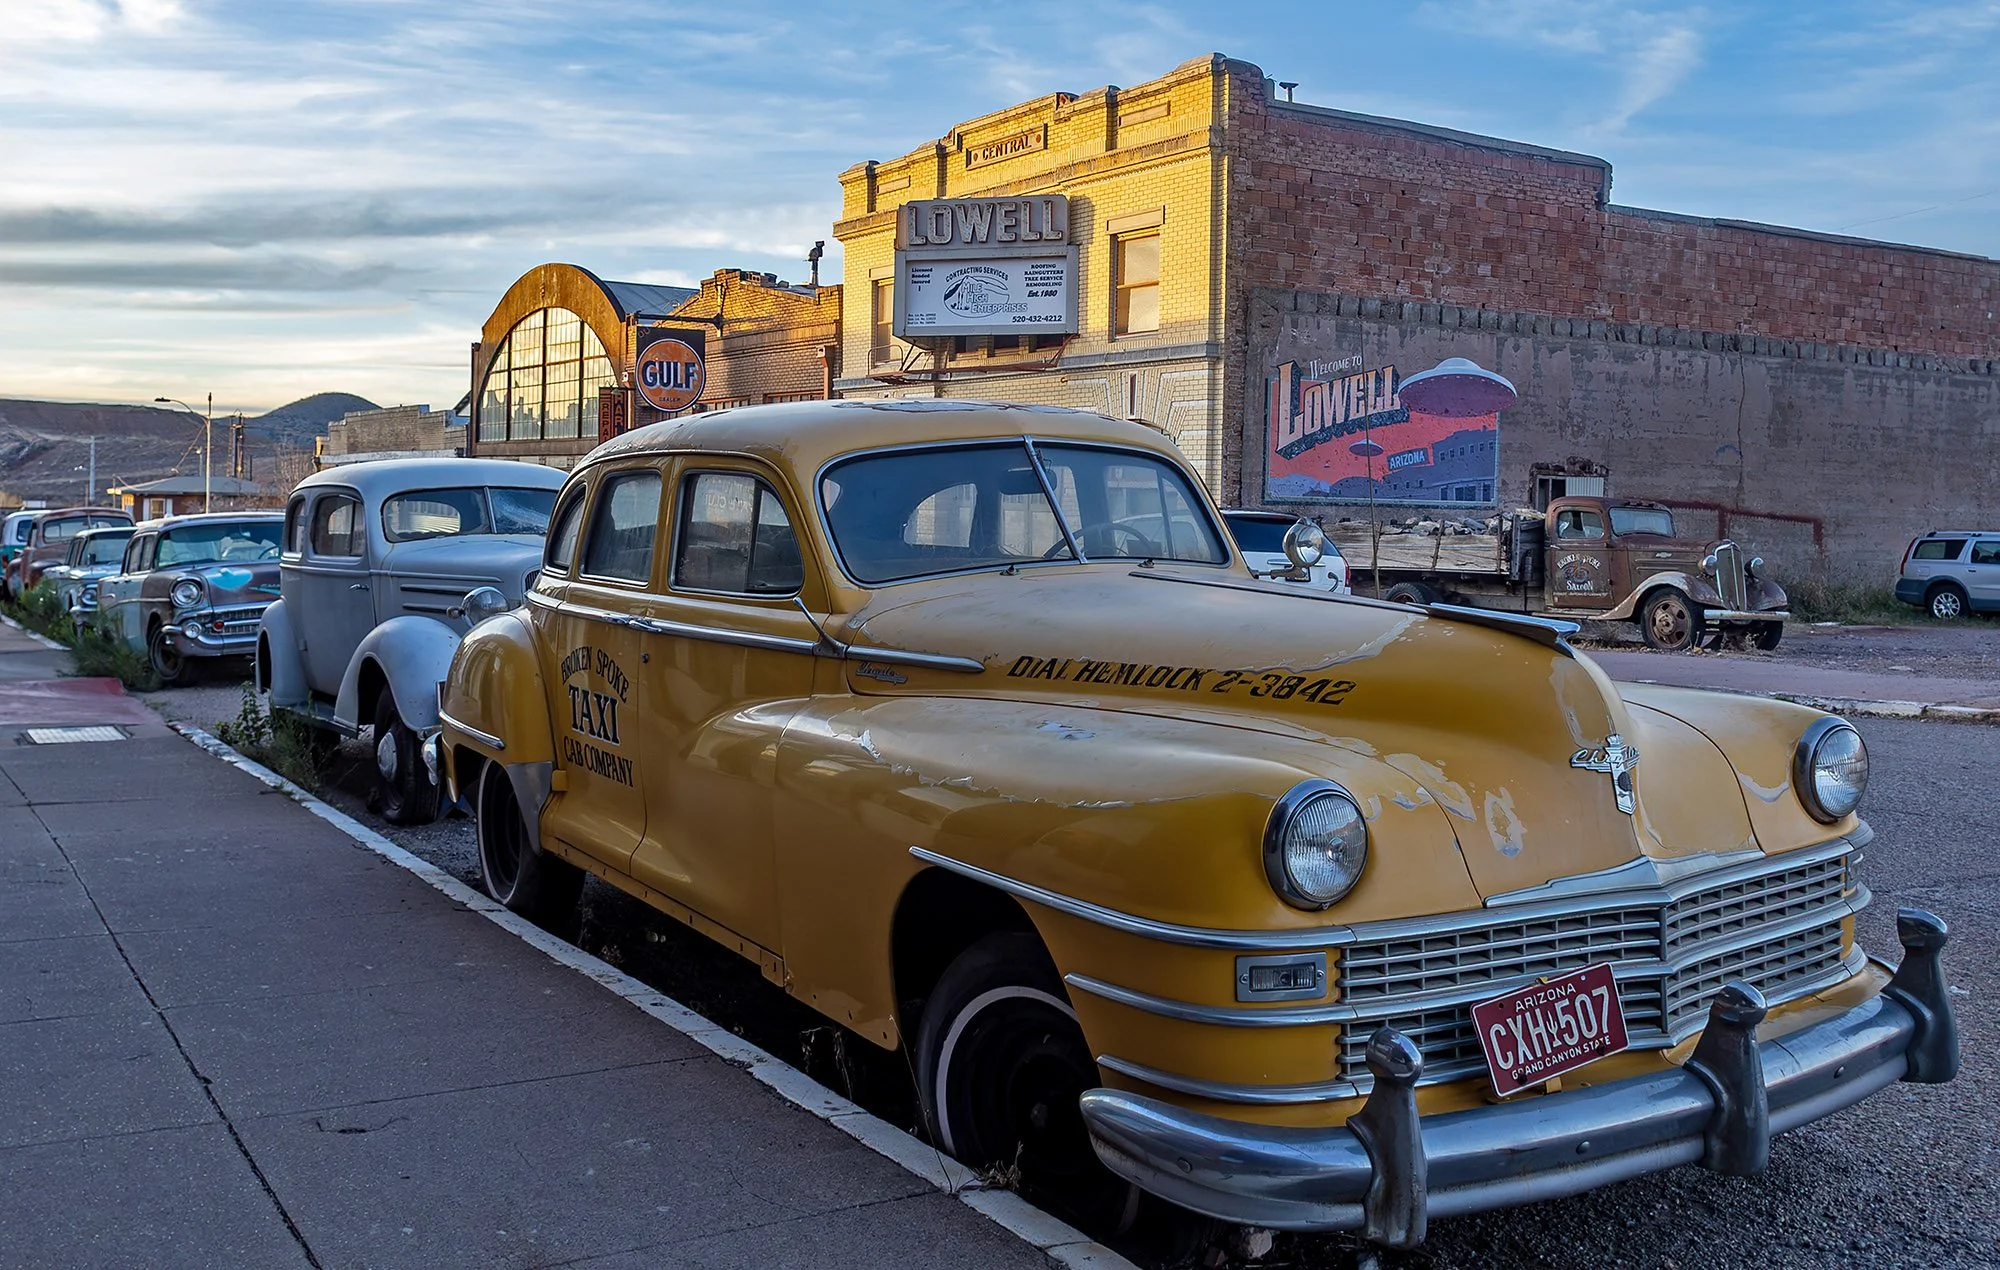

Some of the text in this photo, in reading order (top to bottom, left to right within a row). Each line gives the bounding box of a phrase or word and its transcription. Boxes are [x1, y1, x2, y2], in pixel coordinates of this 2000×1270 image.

[982, 135, 1032, 160] CENTRAL
[907, 200, 1063, 246] LOWELL
[945, 266, 1009, 282] CONTRACTING SERVICES
[961, 281, 983, 293] MILE
[966, 293, 989, 304] HIGH
[1027, 289, 1040, 298] Est.
[971, 302, 1028, 314] ENTERPRISES
[1012, 314, 1063, 323] 520-432-4212
[641, 360, 699, 391] GULF
[1309, 355, 1363, 381] WELCOME TO
[1276, 360, 1404, 456] LOWELL
[1389, 450, 1426, 470] ARIZONA
[560, 646, 629, 703] BROKEN SPOKE
[1007, 655, 1357, 706] DIAL HEMLOCK 2-3842
[569, 684, 621, 746] TAXI
[563, 735, 634, 788] CAB COMPANY
[1515, 982, 1576, 1012] ARIZONA
[1545, 1045, 1583, 1068] CANYON
[1582, 1035, 1611, 1054] STATE
